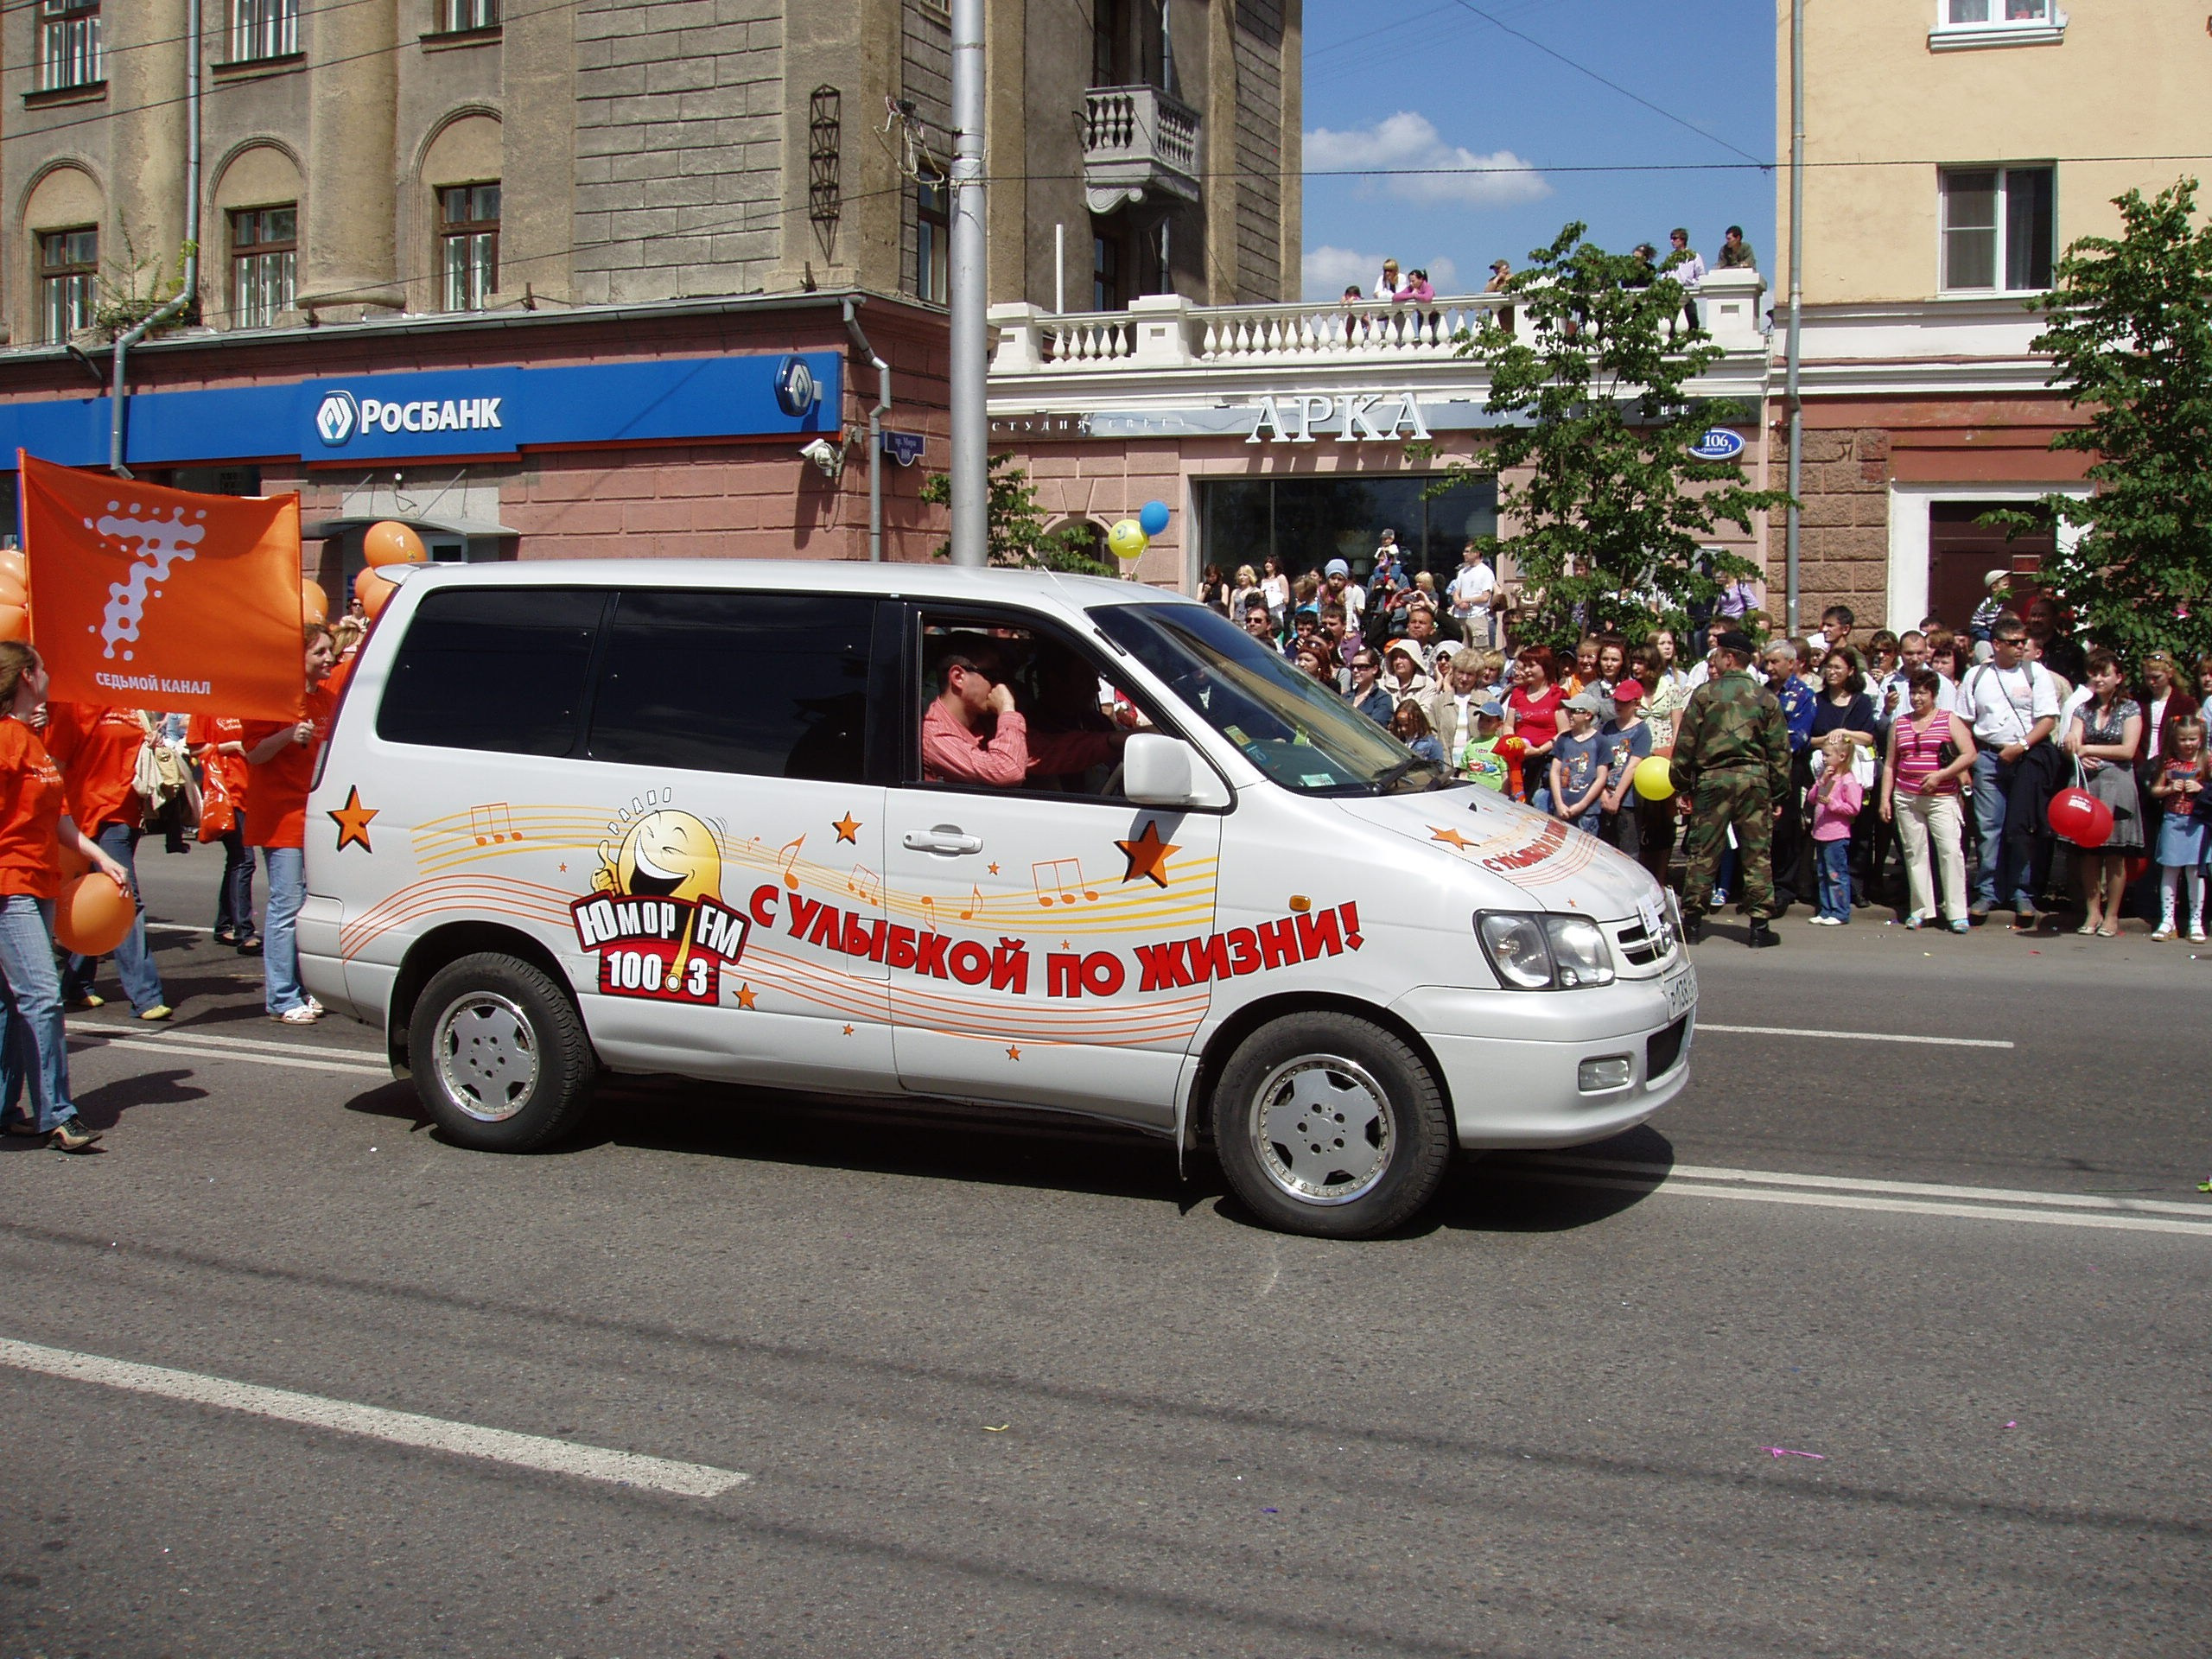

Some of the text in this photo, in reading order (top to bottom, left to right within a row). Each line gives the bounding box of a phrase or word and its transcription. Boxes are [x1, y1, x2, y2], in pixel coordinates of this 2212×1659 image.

[992, 419, 1086, 432] СТУДИЯ
[1245, 392, 1432, 443] АРКА
[1704, 435, 1729, 447] 106
[96, 672, 211, 695] СЕДЬМОЙ КАНАЛ
[696, 905, 745, 959] FM
[749, 884, 1364, 998] С УЛЫБКОЙ ПО ЖИЗНИ!
